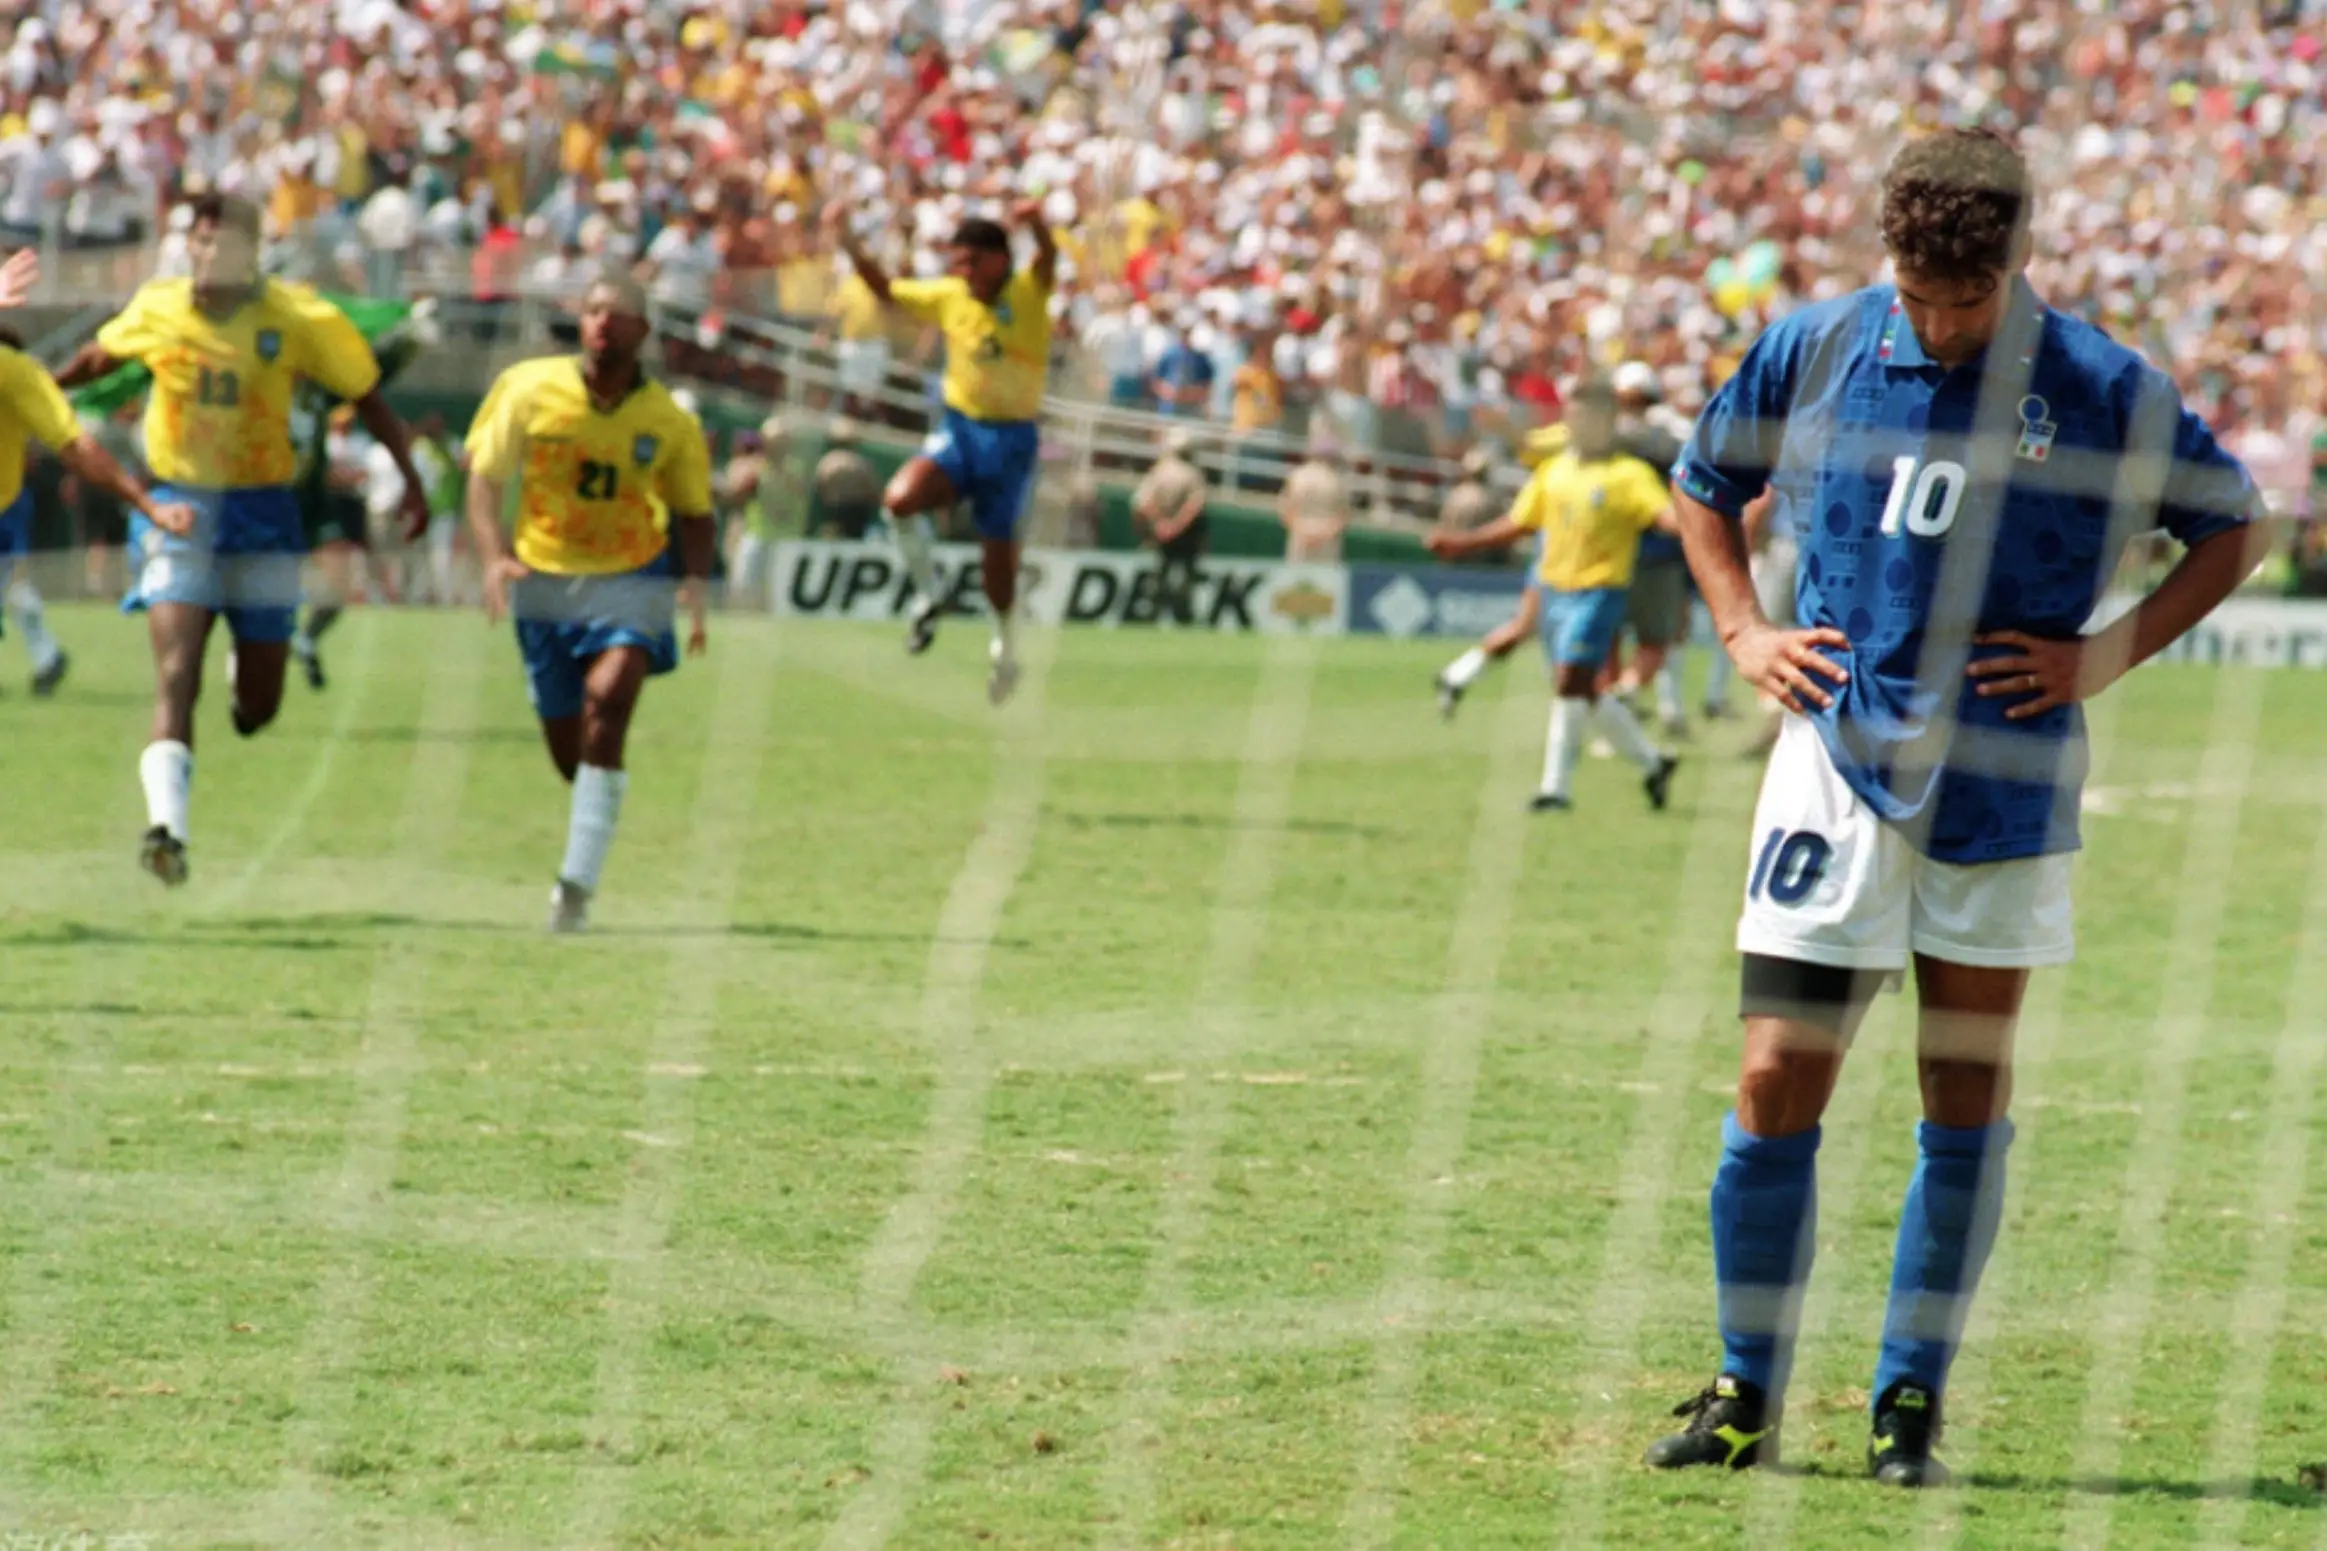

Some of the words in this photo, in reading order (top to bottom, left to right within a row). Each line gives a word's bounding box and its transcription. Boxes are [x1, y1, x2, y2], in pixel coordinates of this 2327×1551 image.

[577, 460, 618, 501] 21
[1880, 455, 1967, 537] 10
[1063, 564, 1264, 627] DEK
[1749, 827, 1833, 909] 10
